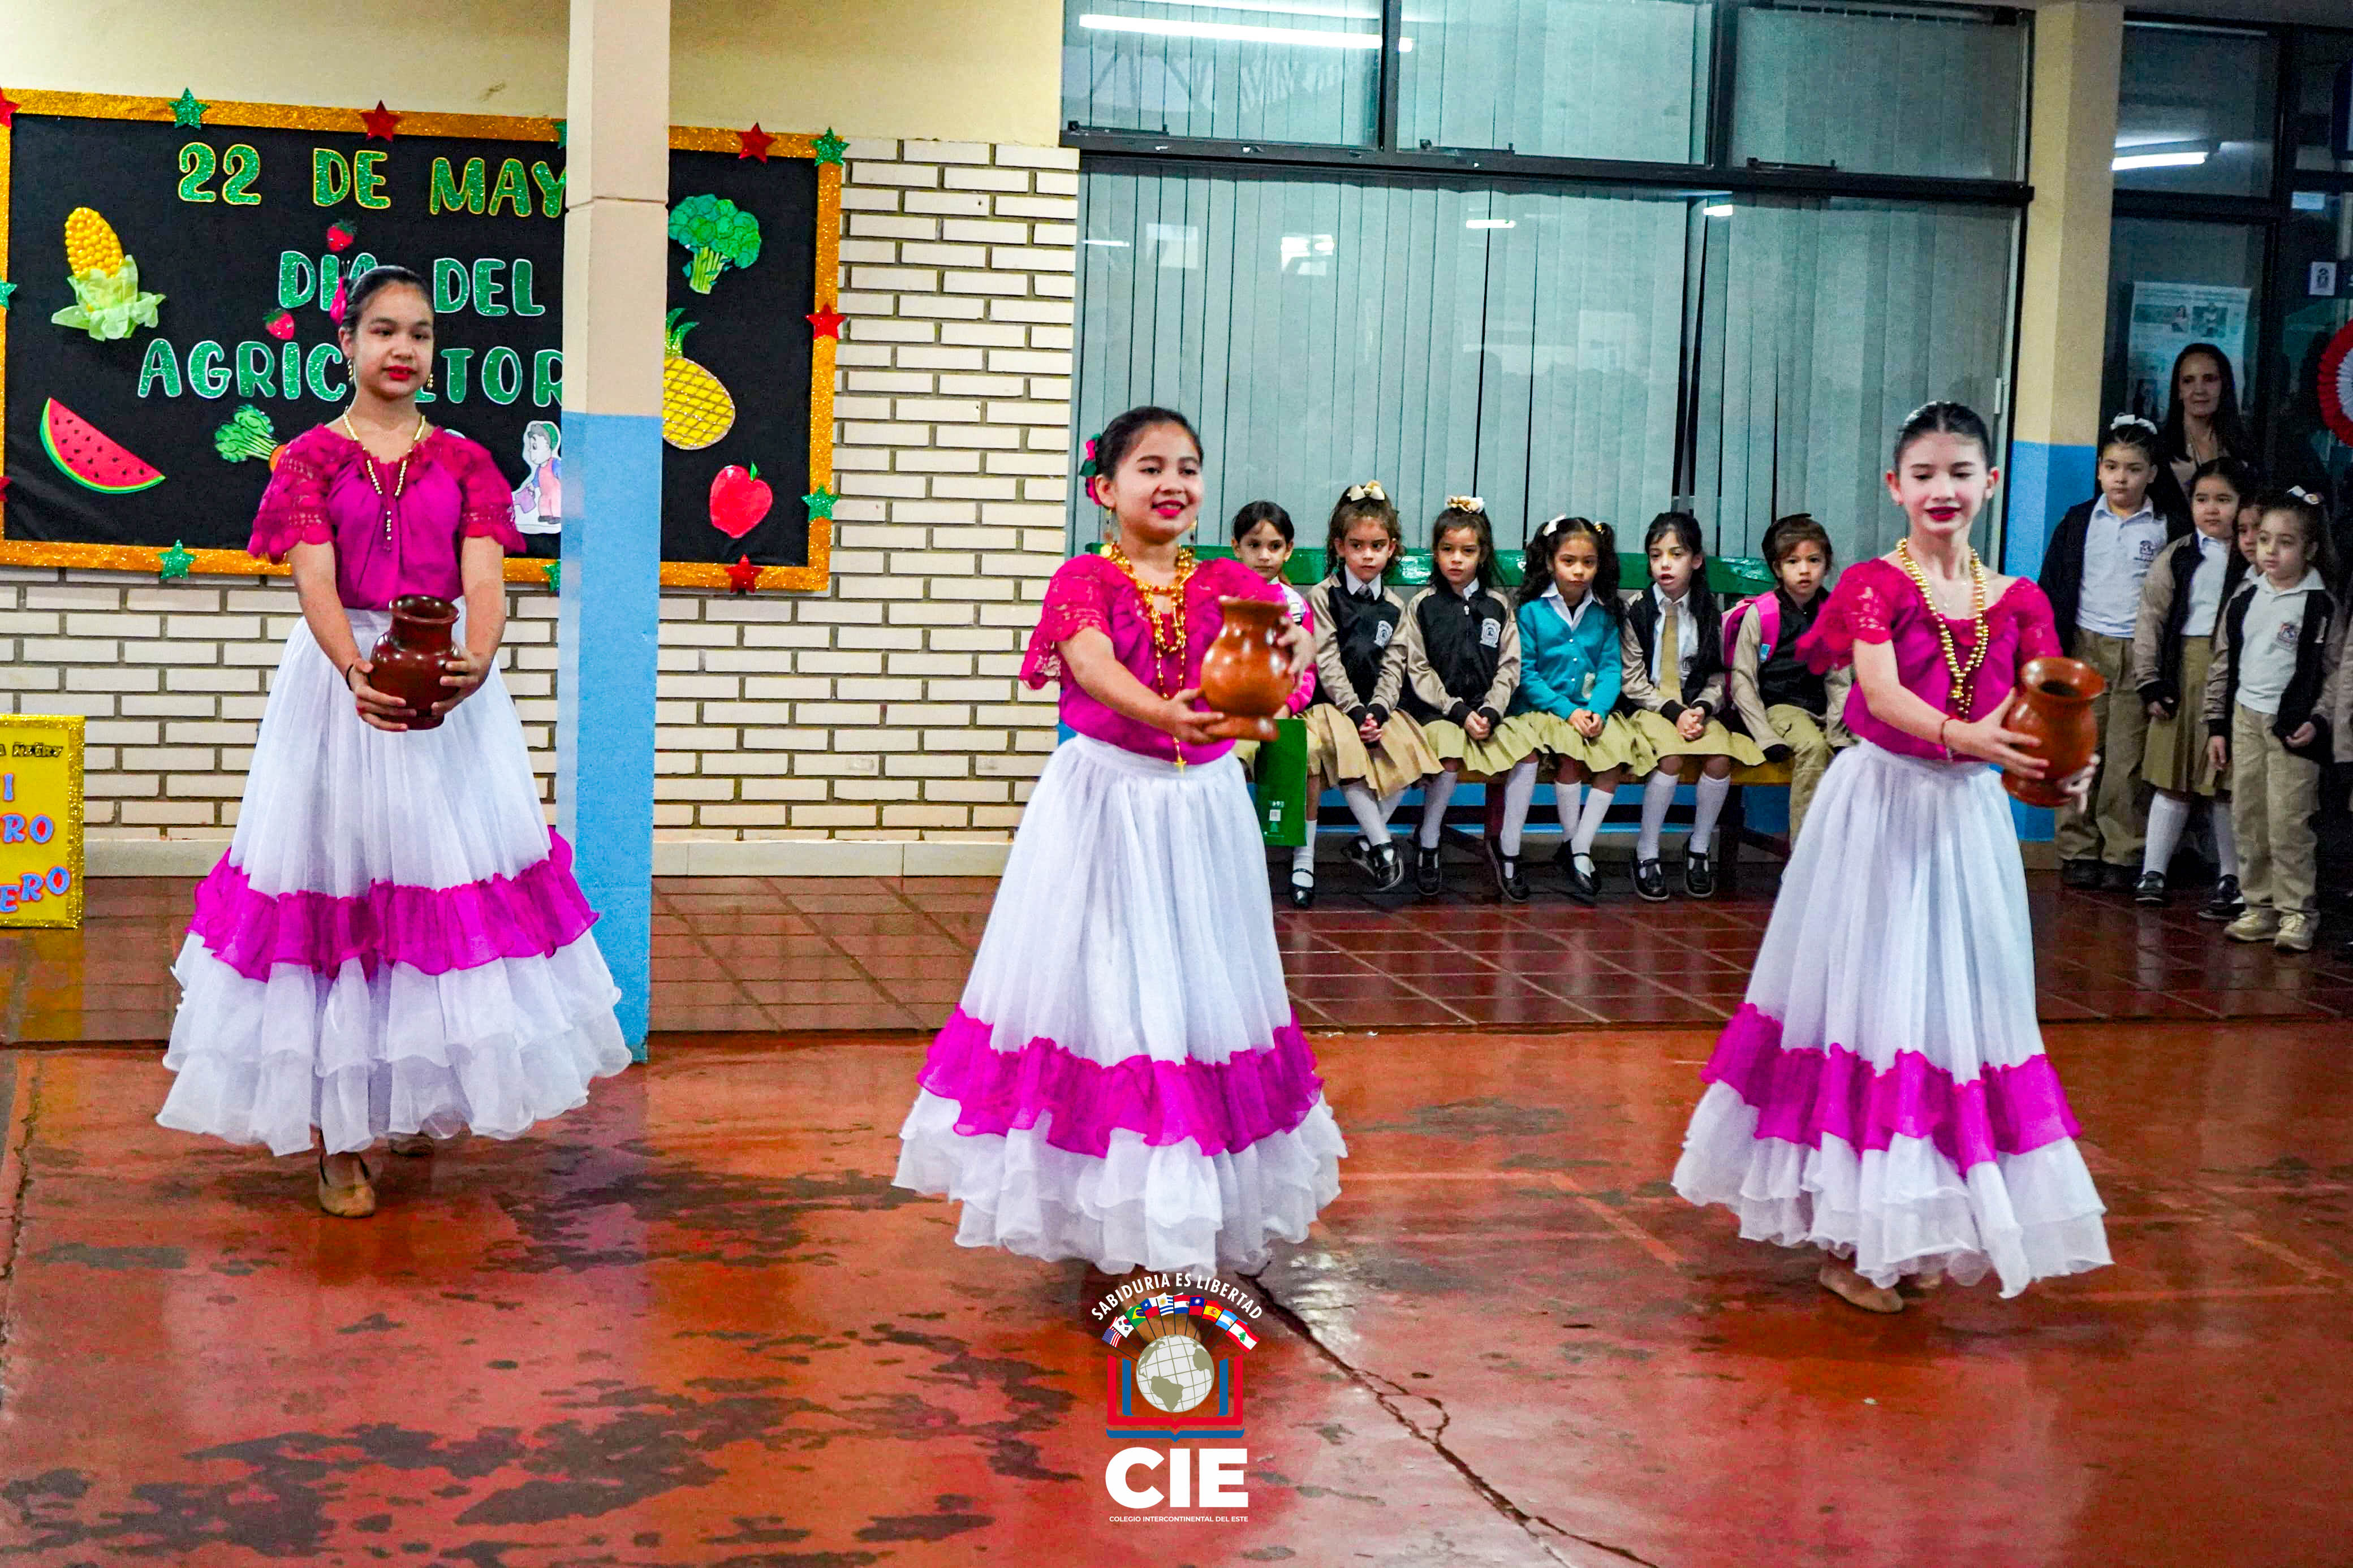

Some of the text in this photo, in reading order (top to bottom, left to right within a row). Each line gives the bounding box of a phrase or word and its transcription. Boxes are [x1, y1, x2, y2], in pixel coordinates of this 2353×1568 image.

[178, 141, 262, 206] 22
[312, 148, 391, 209] DE
[433, 257, 545, 317] DEL
[137, 338, 562, 407] AGRICTOR
